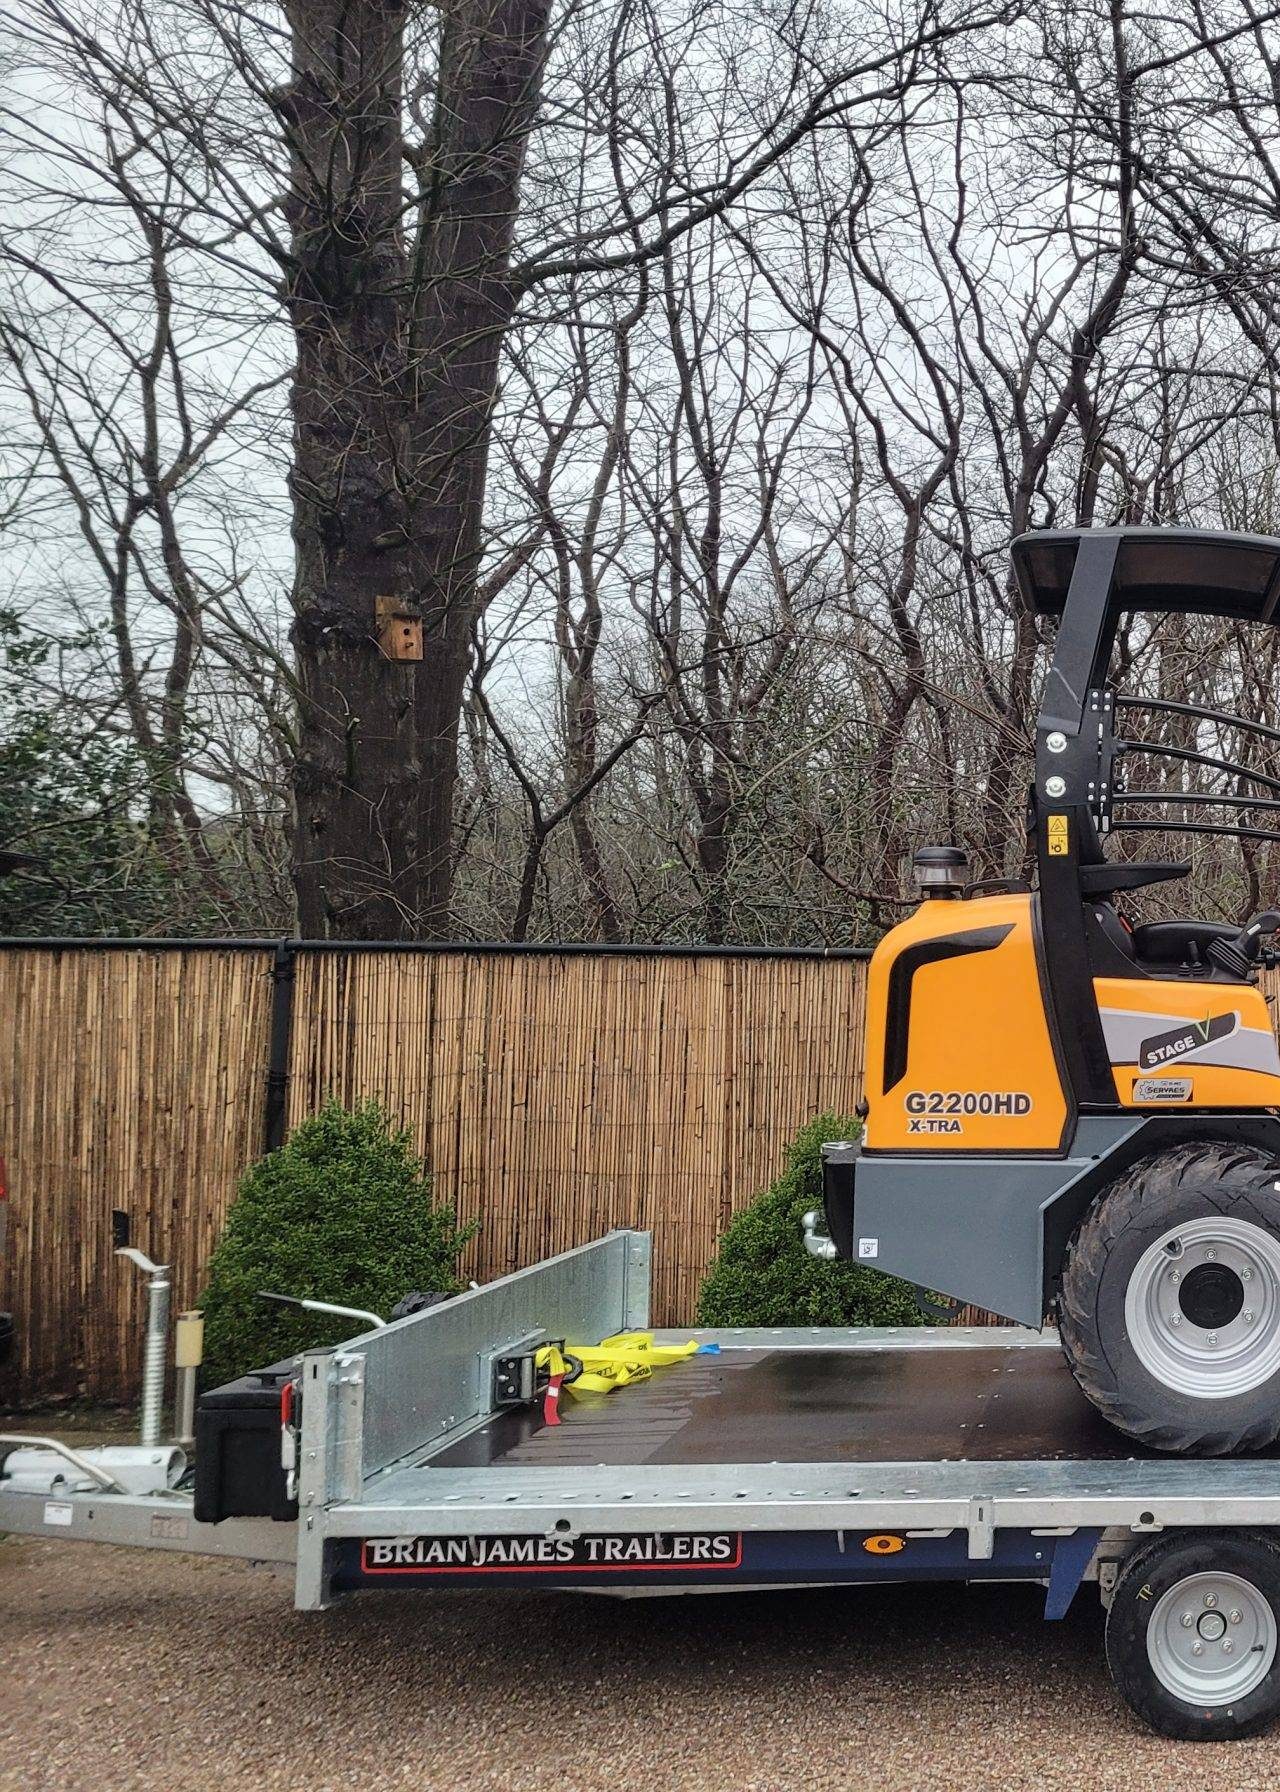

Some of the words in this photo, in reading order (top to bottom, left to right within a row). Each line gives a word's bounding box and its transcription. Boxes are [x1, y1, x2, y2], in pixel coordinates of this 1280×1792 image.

[1147, 1035, 1196, 1064] STAGE
[1195, 1009, 1211, 1042] V
[905, 1092, 1031, 1115] G2200HD
[909, 1119, 961, 1132] X-TRA
[372, 1539, 469, 1564] BRIAN
[472, 1539, 575, 1567] JAMES
[584, 1536, 731, 1561] TRAILERS
